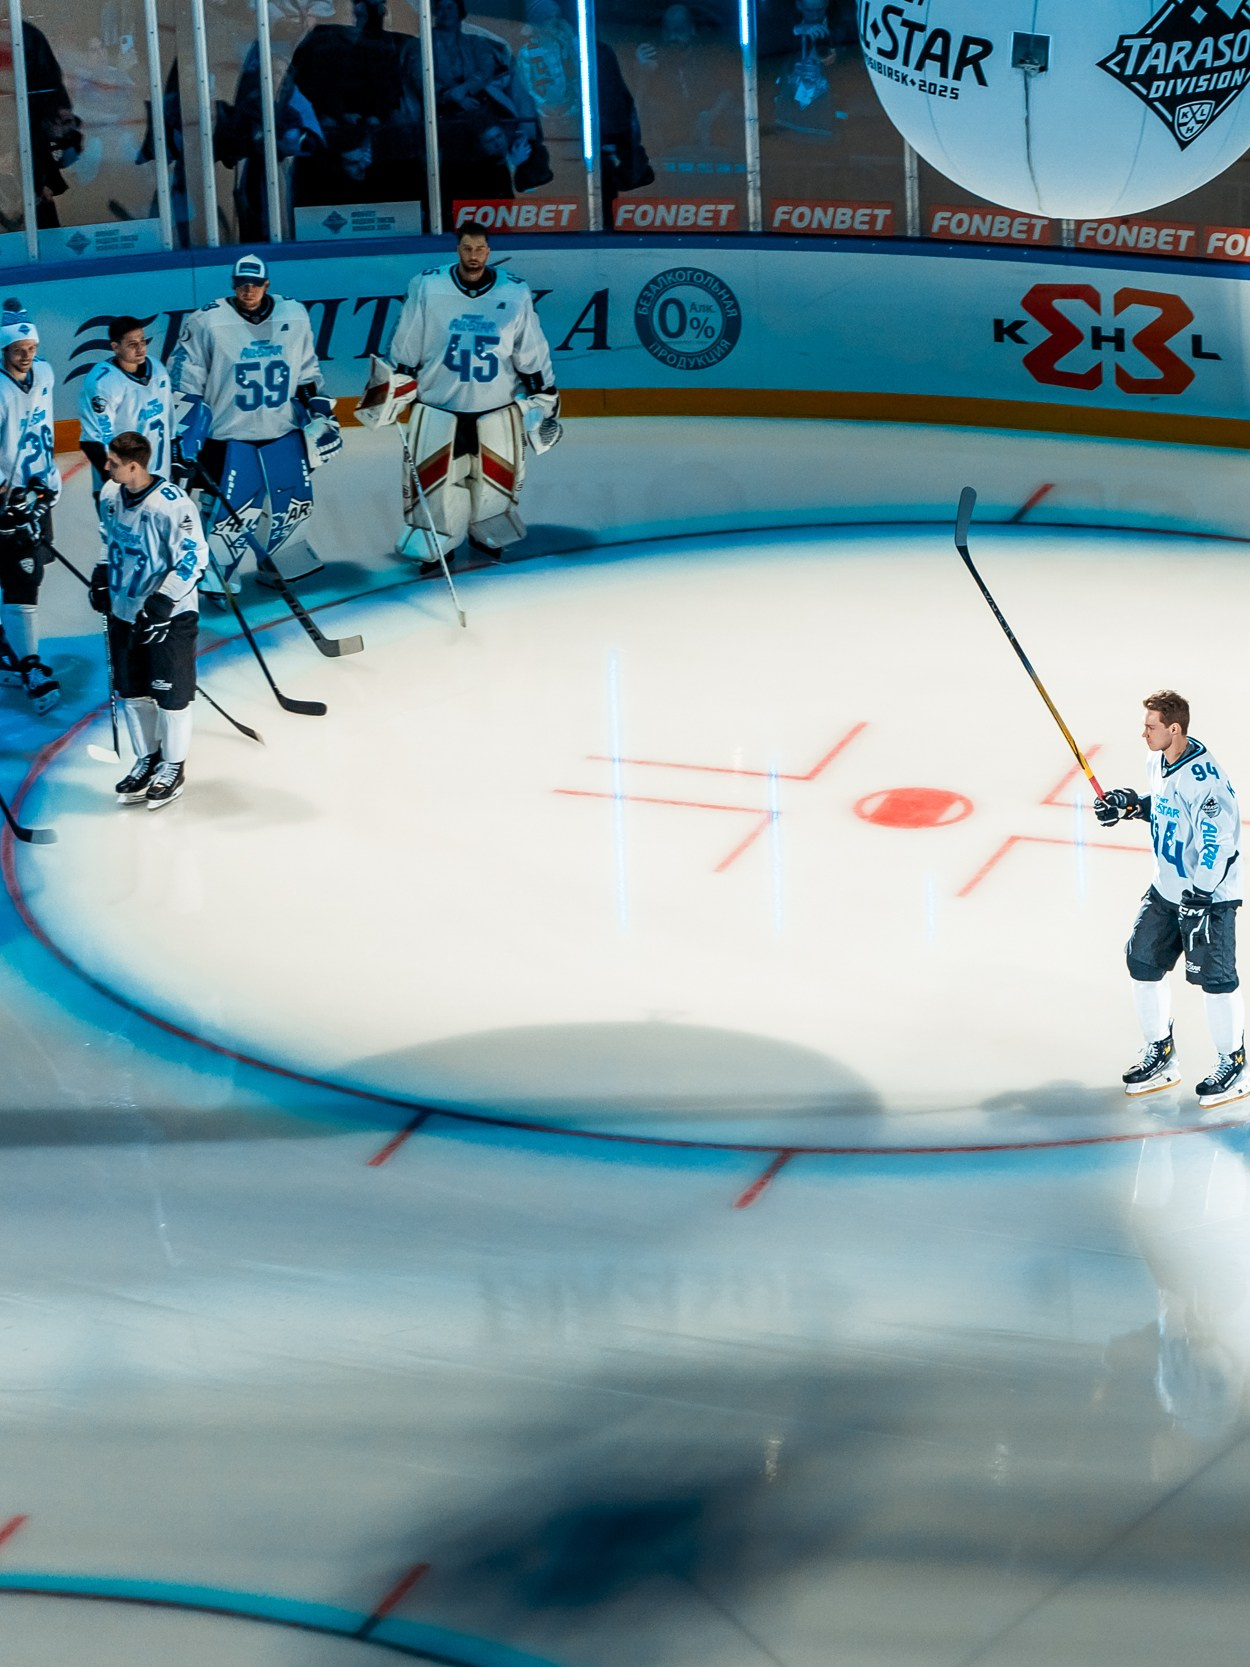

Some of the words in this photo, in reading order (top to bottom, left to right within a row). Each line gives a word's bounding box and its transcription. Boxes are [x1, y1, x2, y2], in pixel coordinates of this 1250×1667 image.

[918, 79, 960, 100] 2025
[1148, 67, 1246, 99] DIVISION
[455, 203, 578, 228] FONBET
[614, 203, 736, 228] FONBET
[772, 205, 892, 231] FONBET
[931, 210, 1049, 240] FONBET
[1078, 221, 1196, 252] FONBET
[637, 270, 738, 317] БЕЗАЛКОГОЛЬНАЯ
[442, 333, 501, 383] 45
[649, 339, 732, 369] ПРОДУКЦИЯ
[234, 359, 290, 412] 59
[160, 484, 184, 501] 87
[108, 540, 149, 598] 87
[1190, 762, 1220, 782] 94
